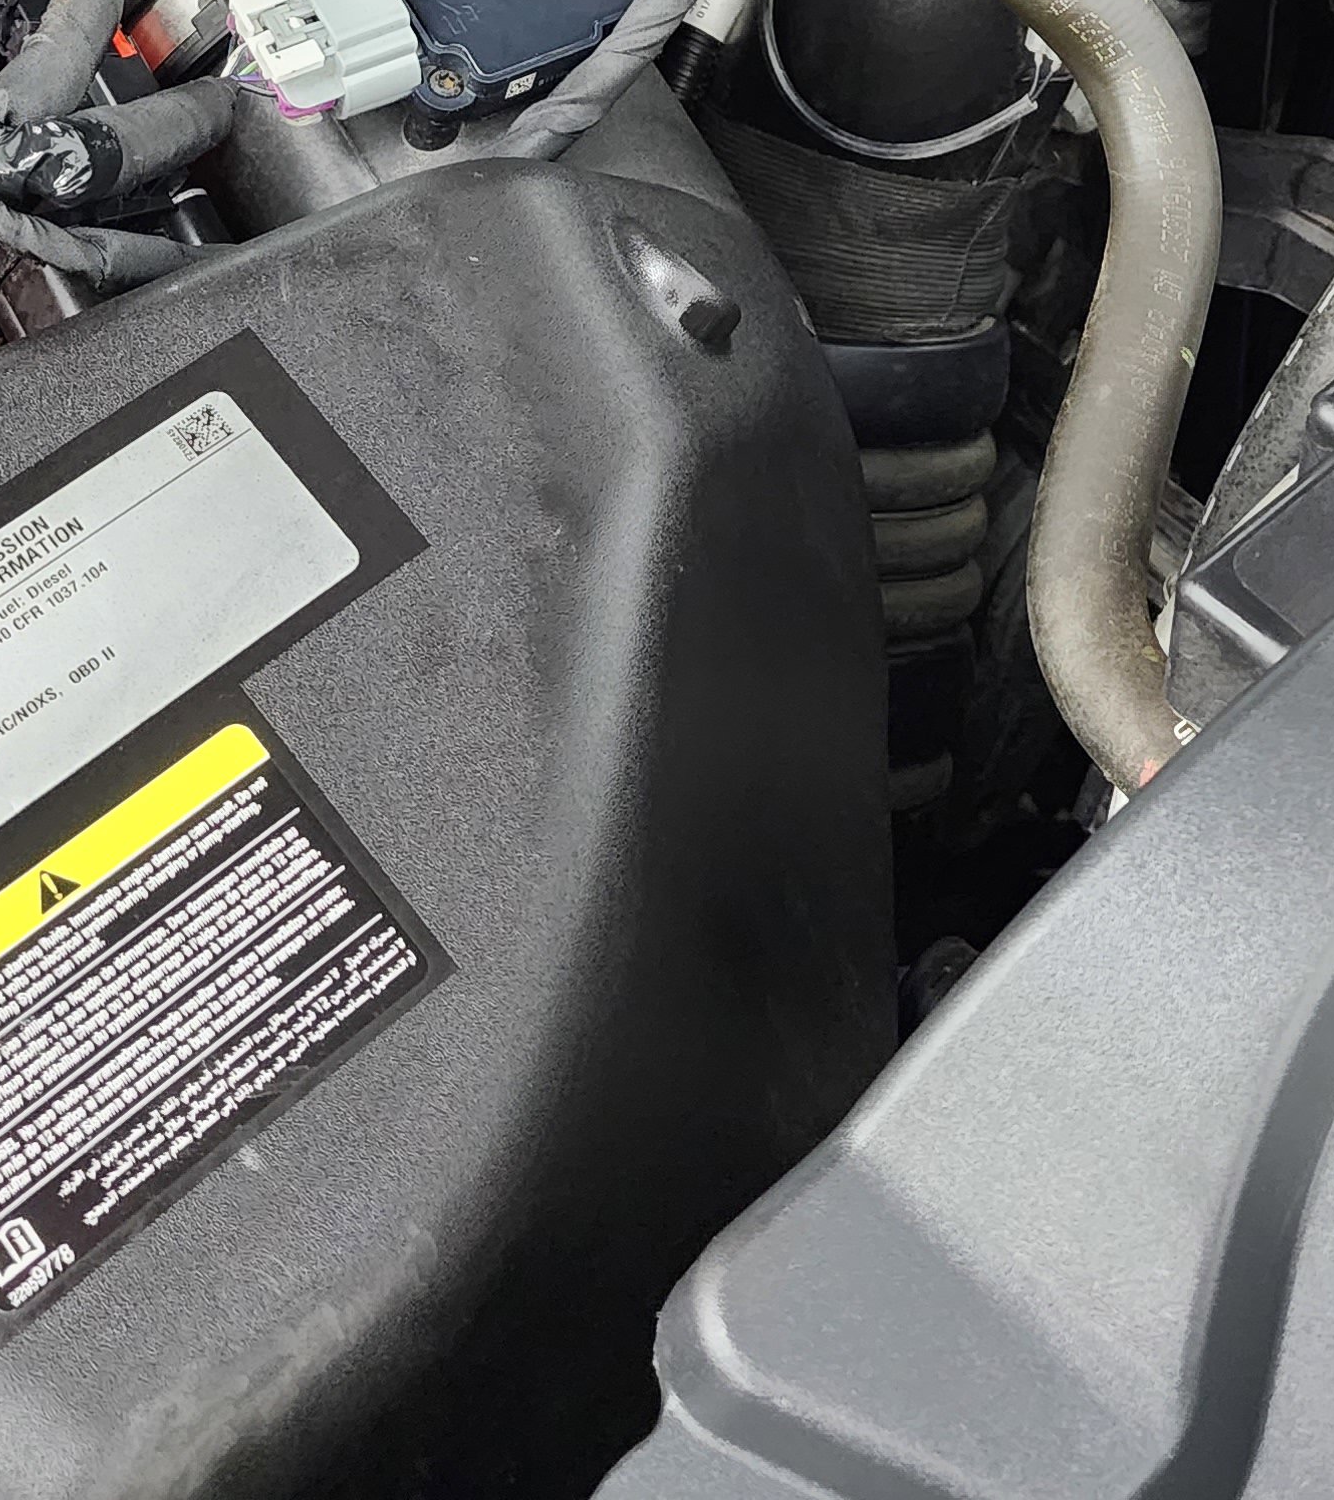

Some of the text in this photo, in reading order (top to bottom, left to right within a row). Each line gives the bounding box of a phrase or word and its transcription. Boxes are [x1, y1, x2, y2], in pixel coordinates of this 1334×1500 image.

[10, 603, 45, 632] CFR
[44, 559, 109, 609] 1037.104
[24, 561, 73, 600] Diesel
[66, 655, 103, 686] OBD
[100, 645, 117, 662] II
